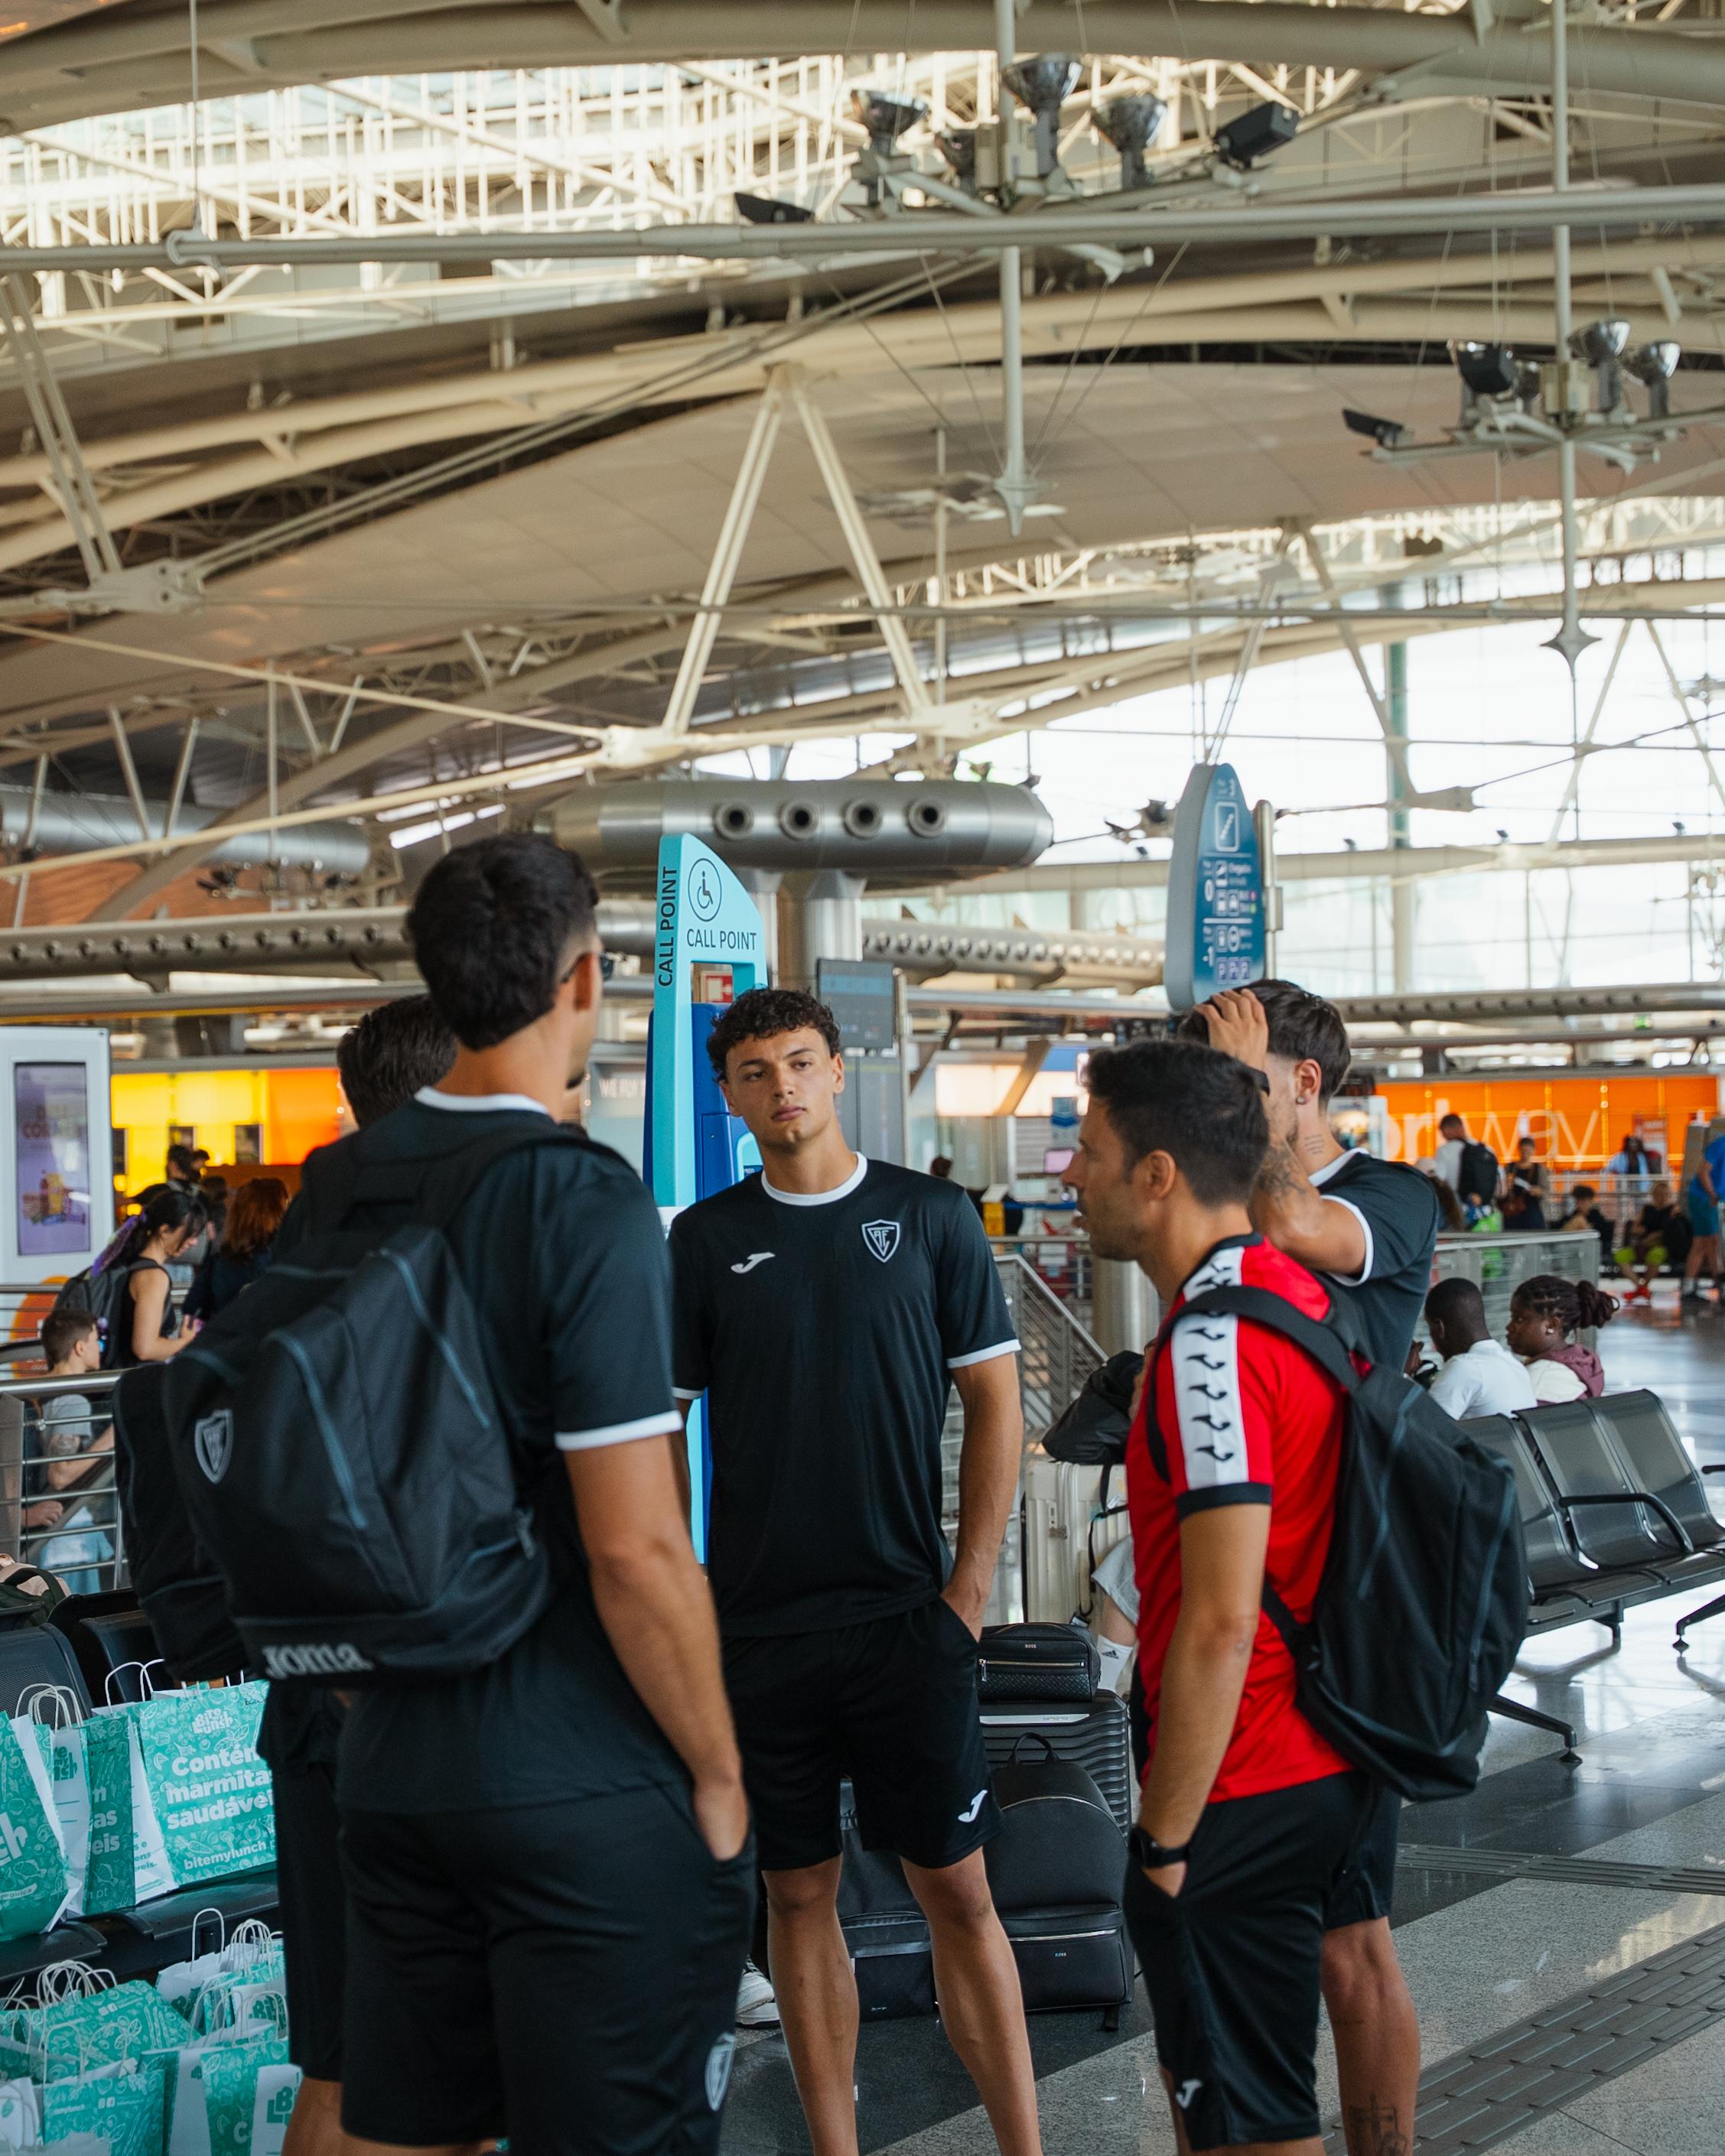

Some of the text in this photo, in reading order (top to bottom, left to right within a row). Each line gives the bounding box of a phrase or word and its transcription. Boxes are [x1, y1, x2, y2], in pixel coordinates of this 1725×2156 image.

[658, 866, 677, 987] CALL POINT
[687, 928, 757, 950] CALL POINT
